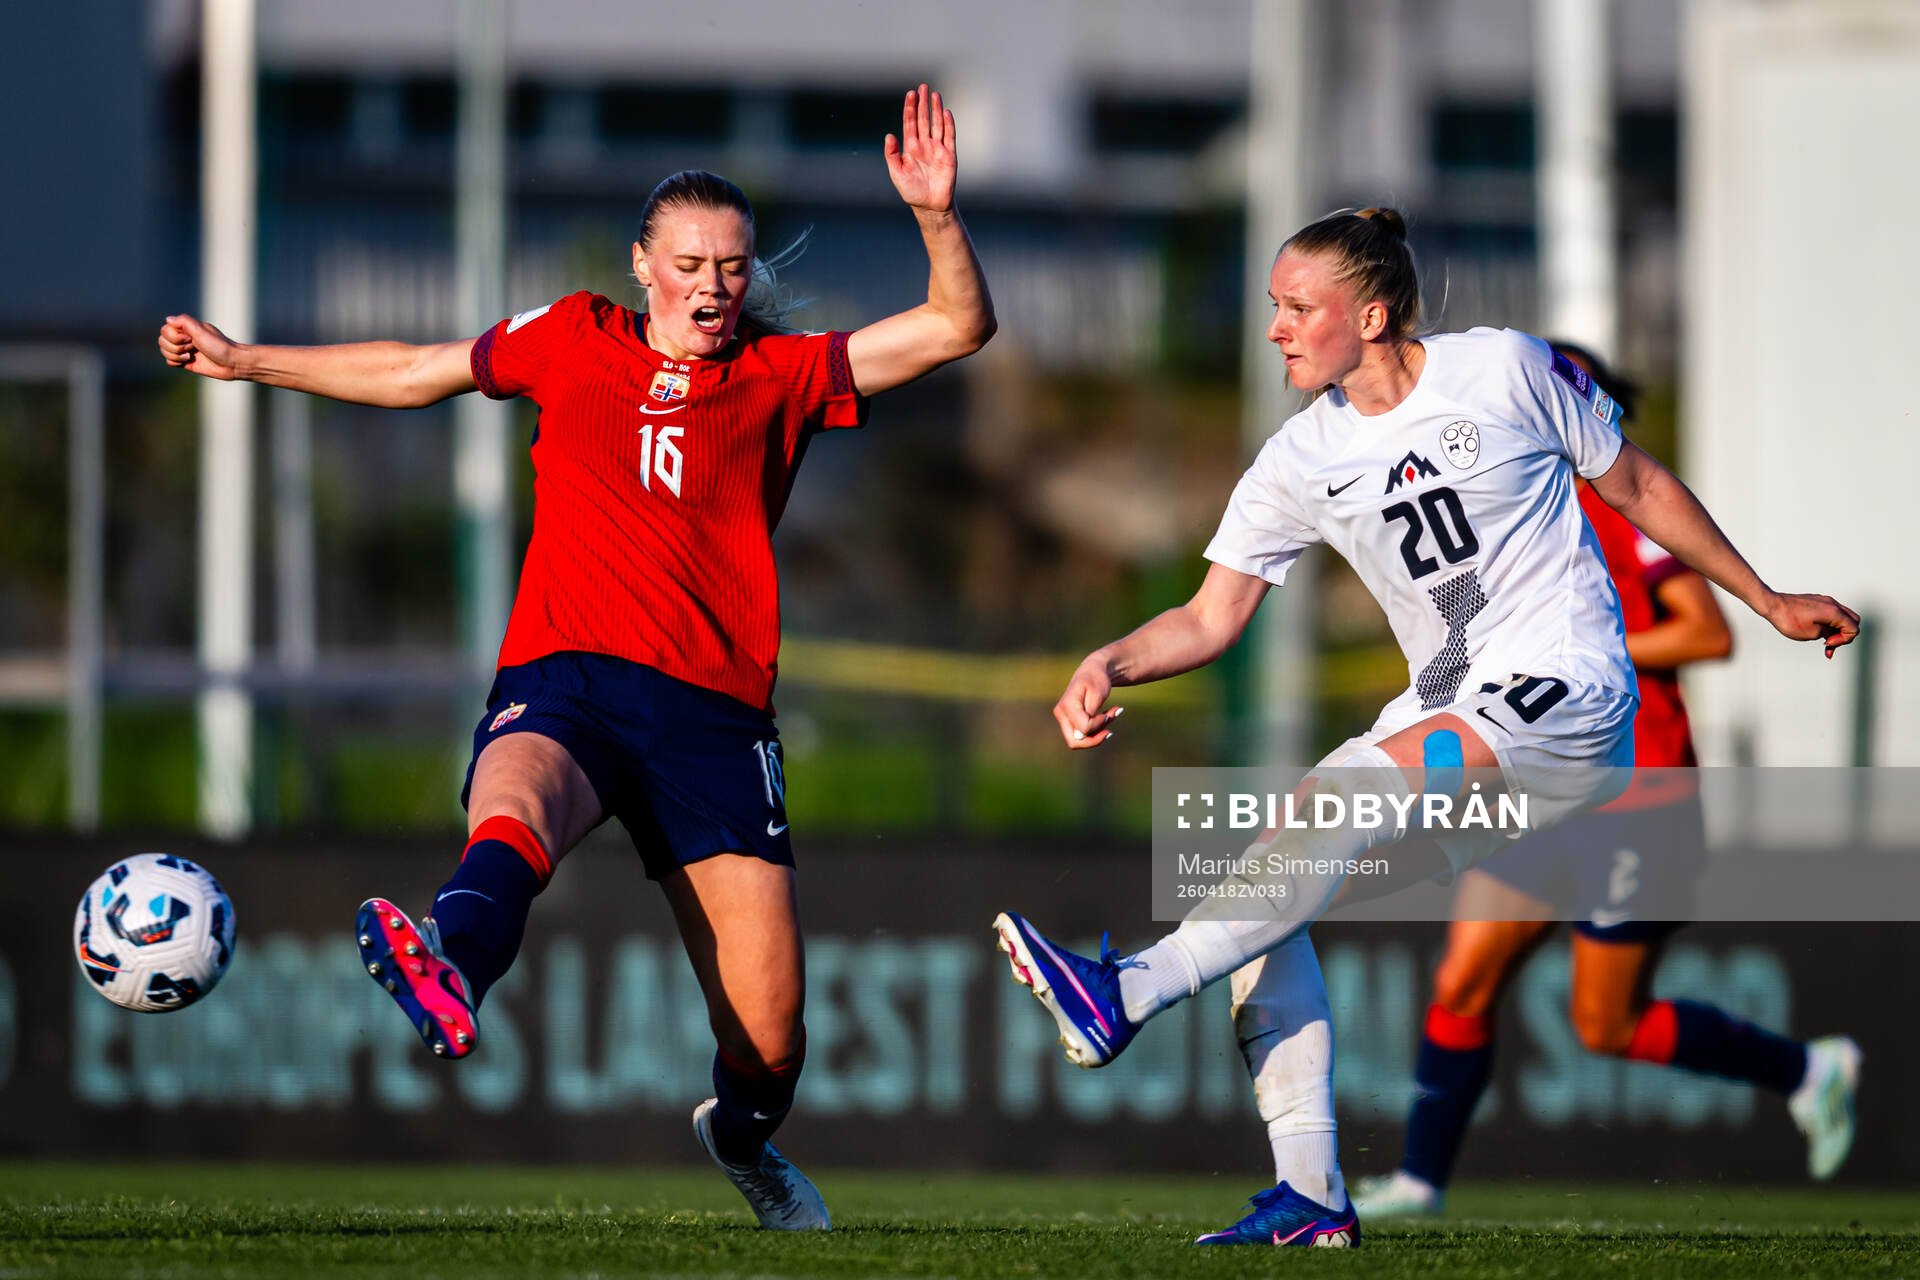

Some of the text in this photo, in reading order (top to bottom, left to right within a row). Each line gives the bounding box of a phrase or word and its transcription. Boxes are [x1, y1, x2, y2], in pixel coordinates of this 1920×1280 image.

[637, 424, 685, 499] 16
[1381, 486, 1480, 581] 20
[1480, 673, 1570, 724] 0
